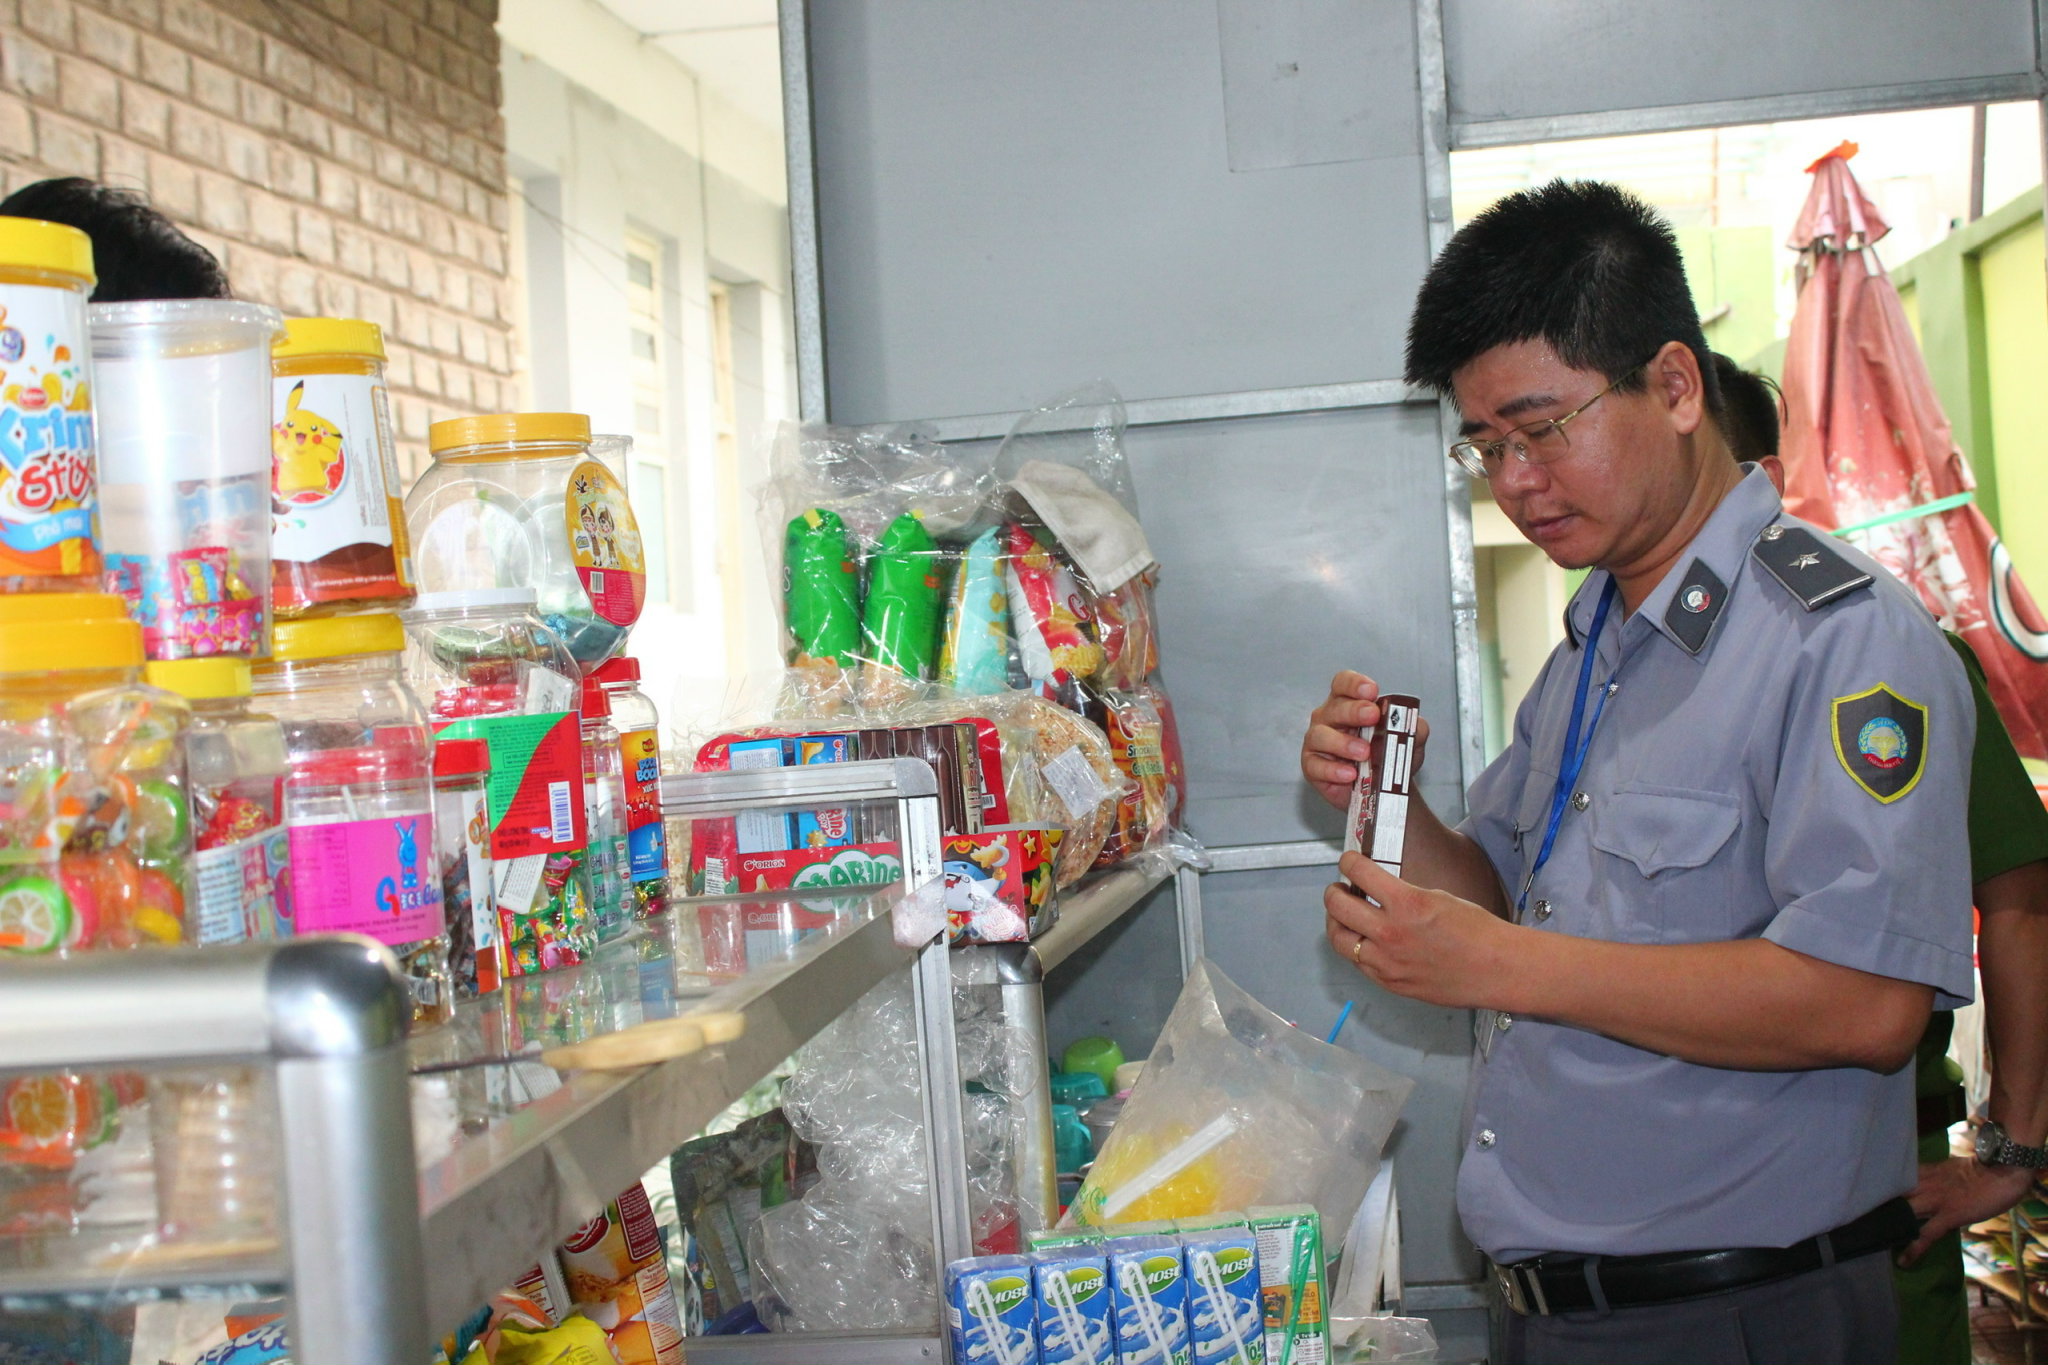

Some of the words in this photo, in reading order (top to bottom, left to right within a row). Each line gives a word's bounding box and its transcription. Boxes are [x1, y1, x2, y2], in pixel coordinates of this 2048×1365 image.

[638, 757, 658, 770] BOO
[635, 768, 659, 782] BOO
[755, 859, 786, 869] ORION
